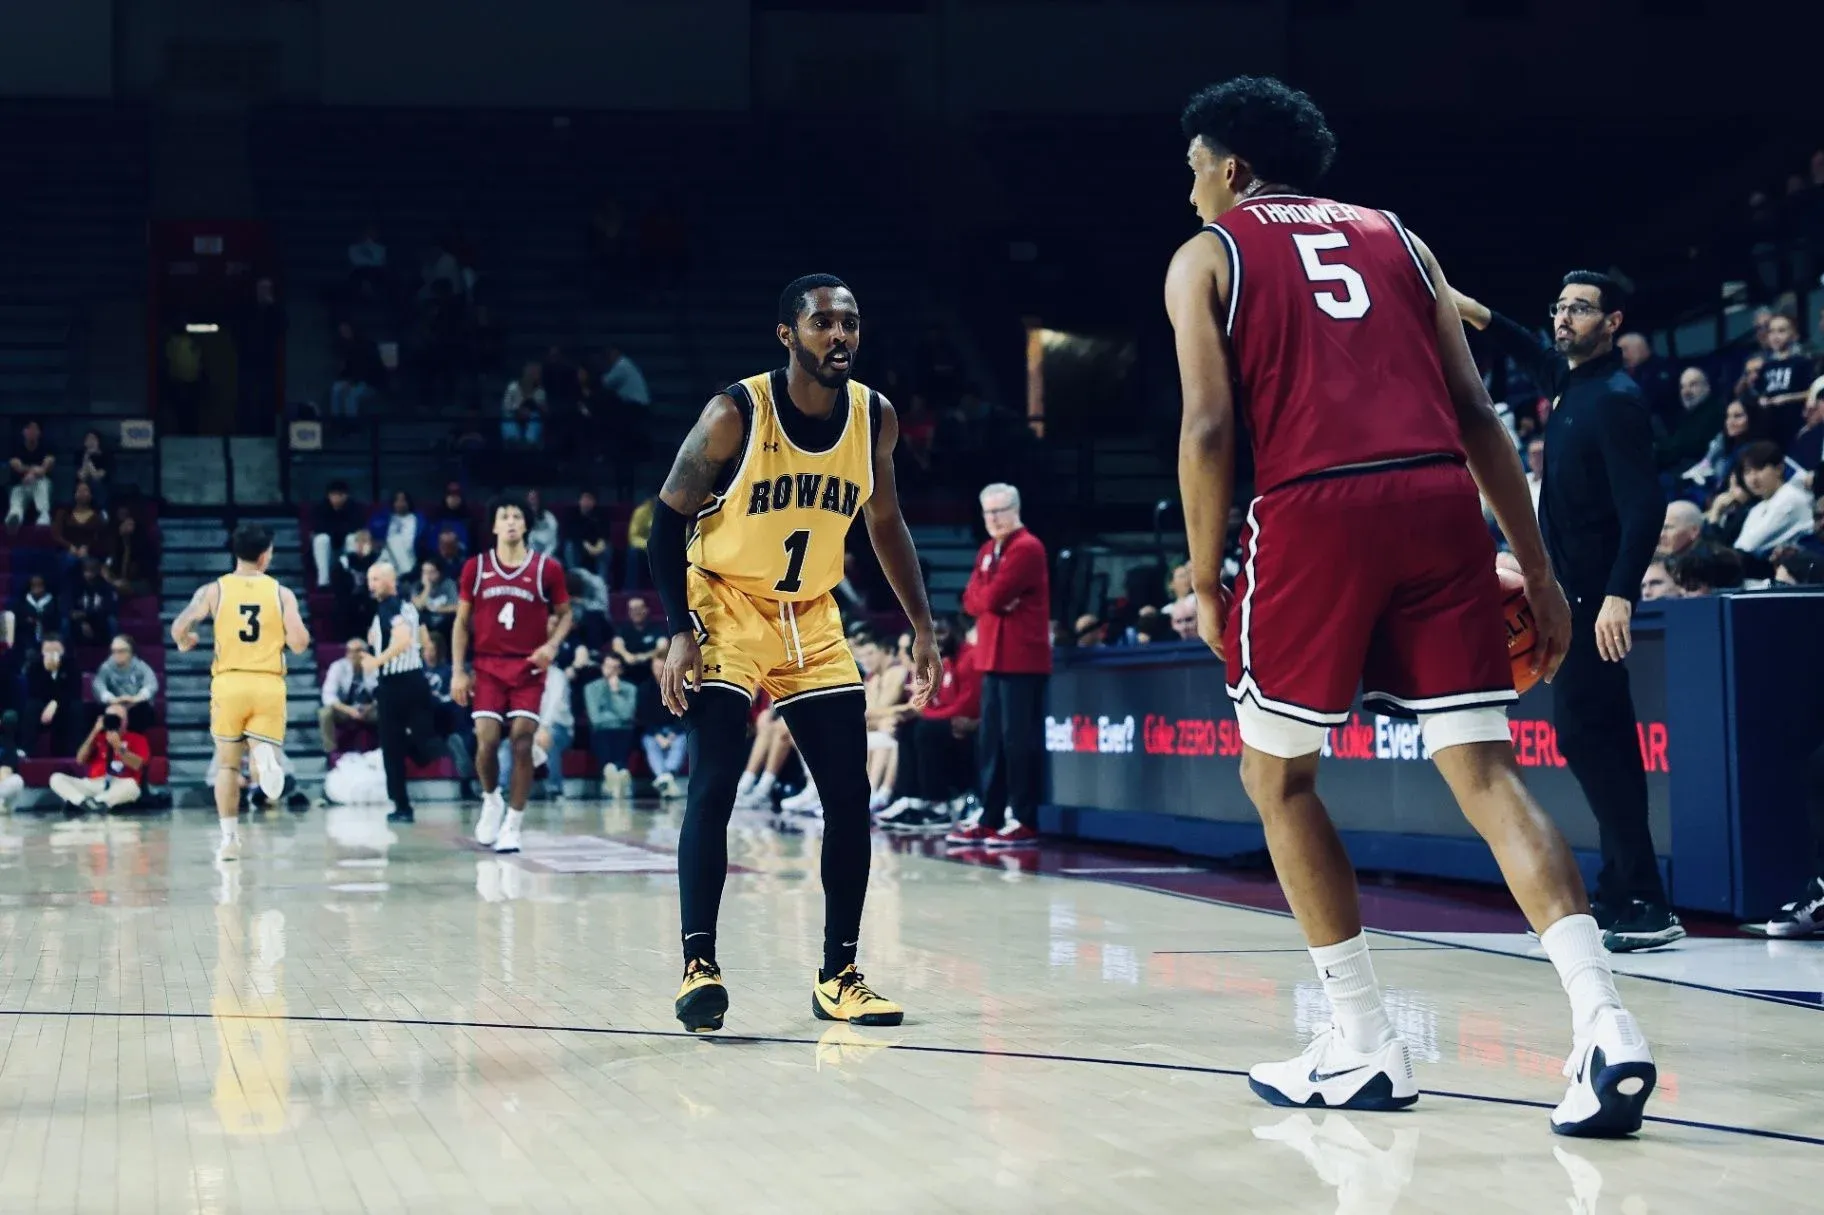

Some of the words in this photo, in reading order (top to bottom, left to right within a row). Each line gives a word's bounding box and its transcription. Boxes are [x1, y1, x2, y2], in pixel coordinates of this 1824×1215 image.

[1243, 203, 1362, 224] THROWER
[1291, 231, 1371, 319] 5
[746, 473, 860, 519] ROWAN
[772, 528, 811, 593] 1
[239, 604, 261, 642] 3
[497, 601, 515, 631] 4
[1176, 719, 1217, 755] ZERO
[1218, 719, 1243, 755] SU
[1331, 713, 1375, 759] Coke
[1375, 714, 1429, 759] Ever
